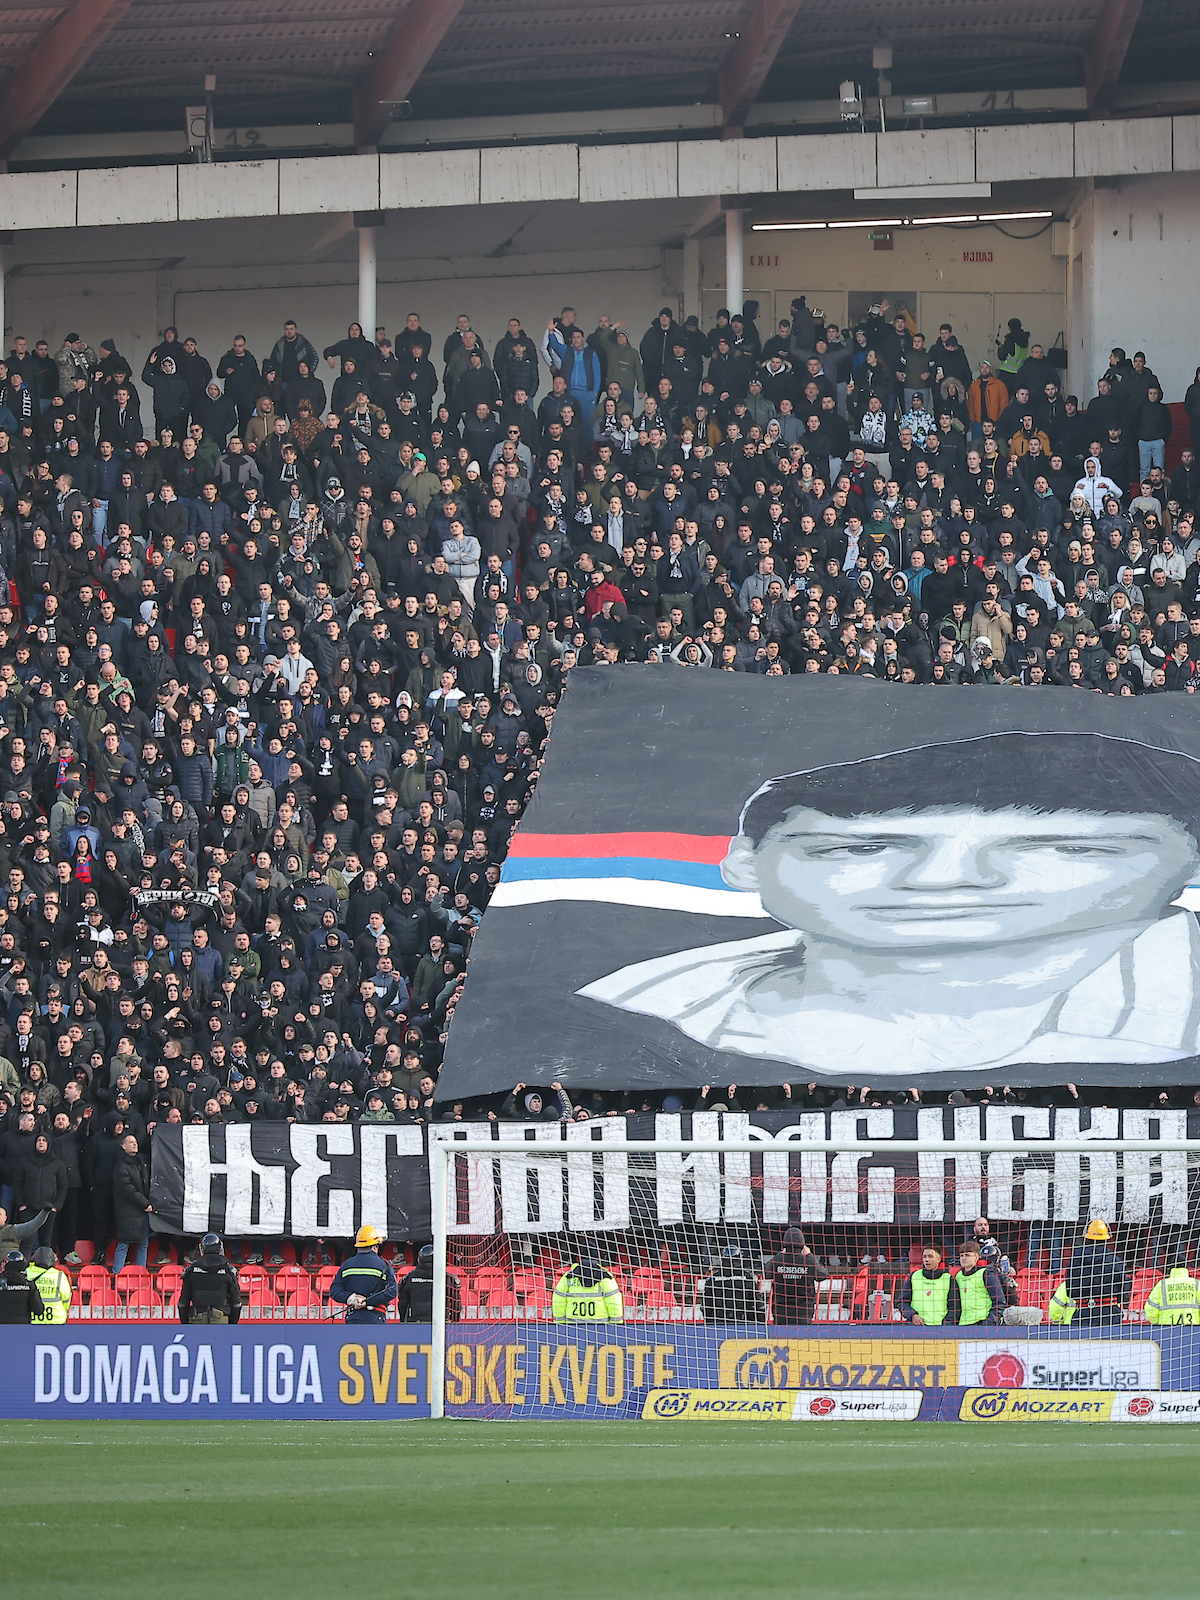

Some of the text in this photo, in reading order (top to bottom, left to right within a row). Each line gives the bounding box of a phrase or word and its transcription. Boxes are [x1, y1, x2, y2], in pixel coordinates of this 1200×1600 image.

[749, 255, 780, 267] EXIT
[963, 251, 993, 263] ИЗЛАЗ
[181, 1117, 628, 1237] ЊЕГОВО
[917, 1104, 1190, 1226] НЕКА
[1168, 1292, 1194, 1302] SECURITY
[572, 1301, 596, 1317] 200
[1169, 1312, 1193, 1326] 143
[34, 1333, 674, 1406] DOMAĆA LIGA SVETSKE KVOTE
[800, 1365, 946, 1387] MOZZART
[1032, 1366, 1140, 1389] SuperLiga
[693, 1399, 788, 1412] MOZZART
[840, 1400, 908, 1414] SuperLiga
[1010, 1400, 1105, 1413] MOZZART
